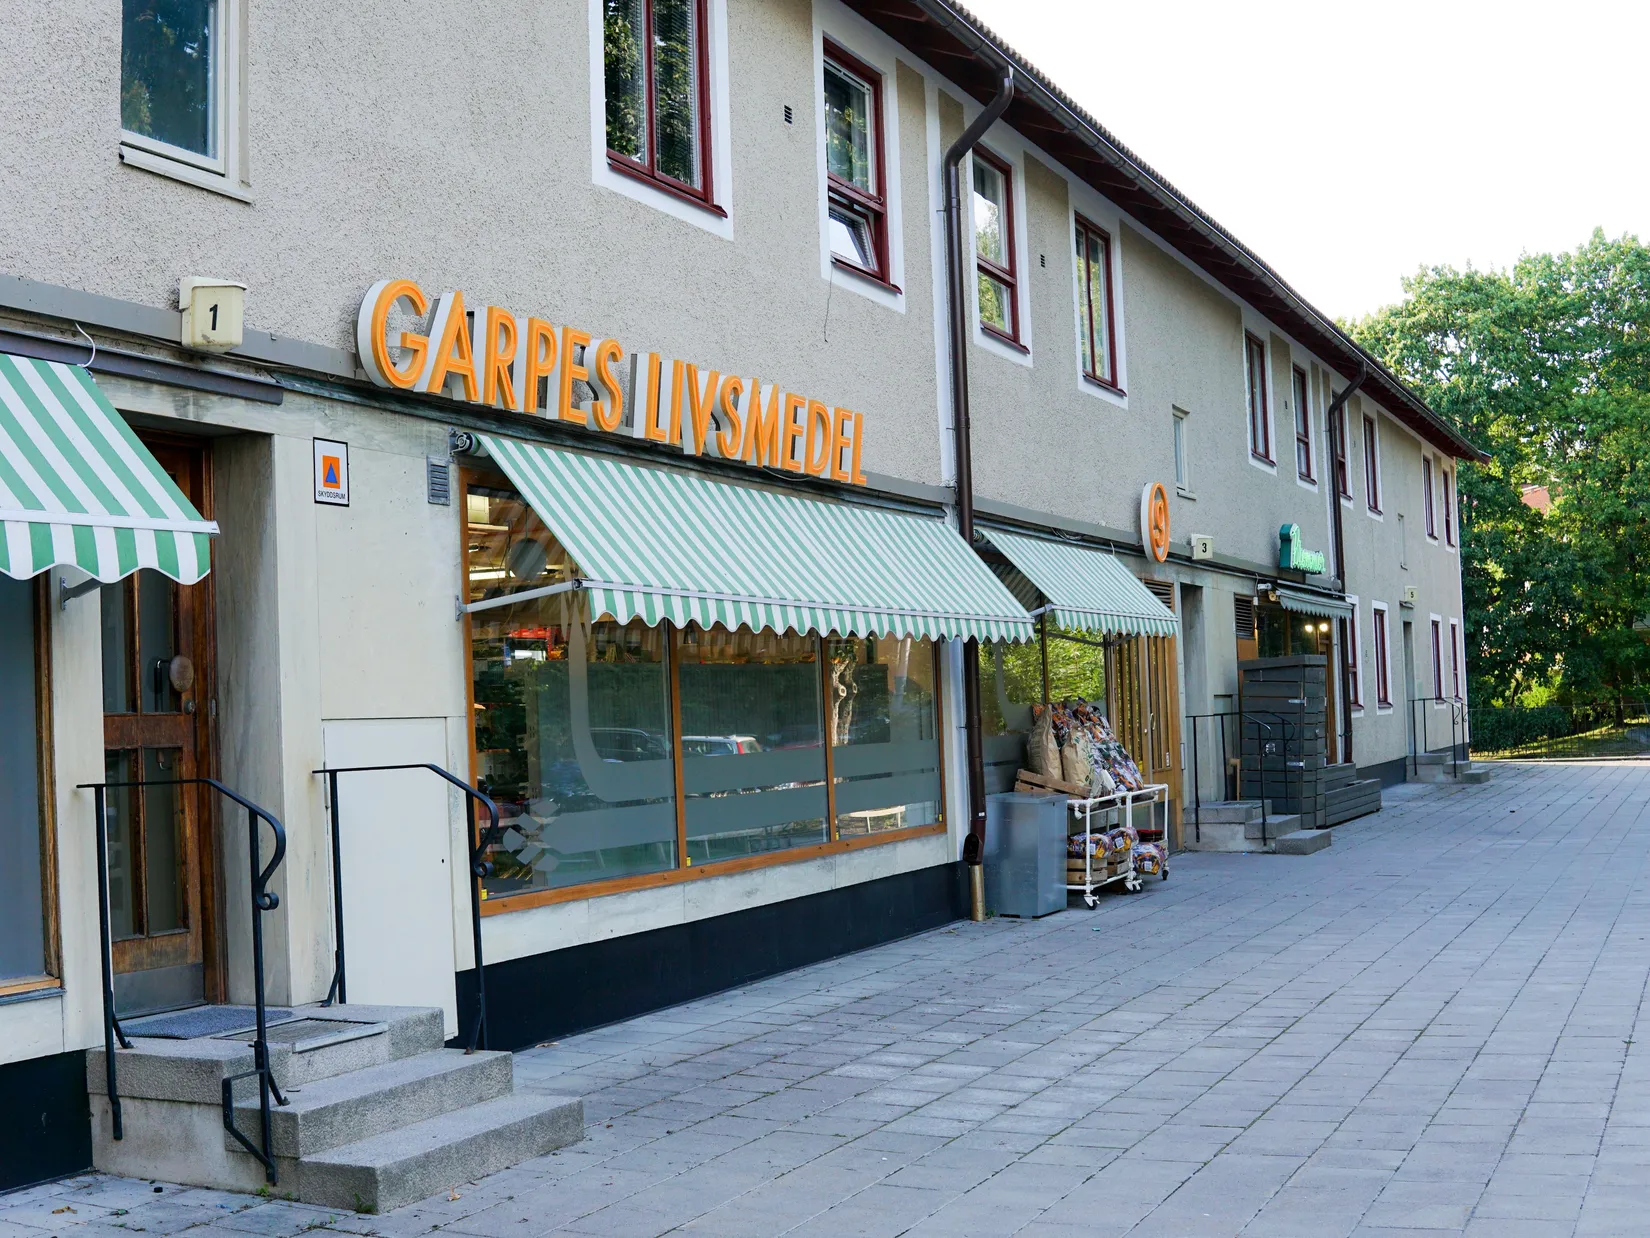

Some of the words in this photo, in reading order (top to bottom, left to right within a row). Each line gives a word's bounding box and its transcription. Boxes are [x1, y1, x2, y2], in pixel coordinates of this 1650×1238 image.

[208, 303, 219, 331] 1
[360, 278, 624, 433] GARPES
[636, 352, 868, 487] LIVSMEDEL
[317, 489, 346, 500] SKYDDSRUM
[1201, 542, 1208, 554] 3
[1410, 591, 1415, 599] 5
